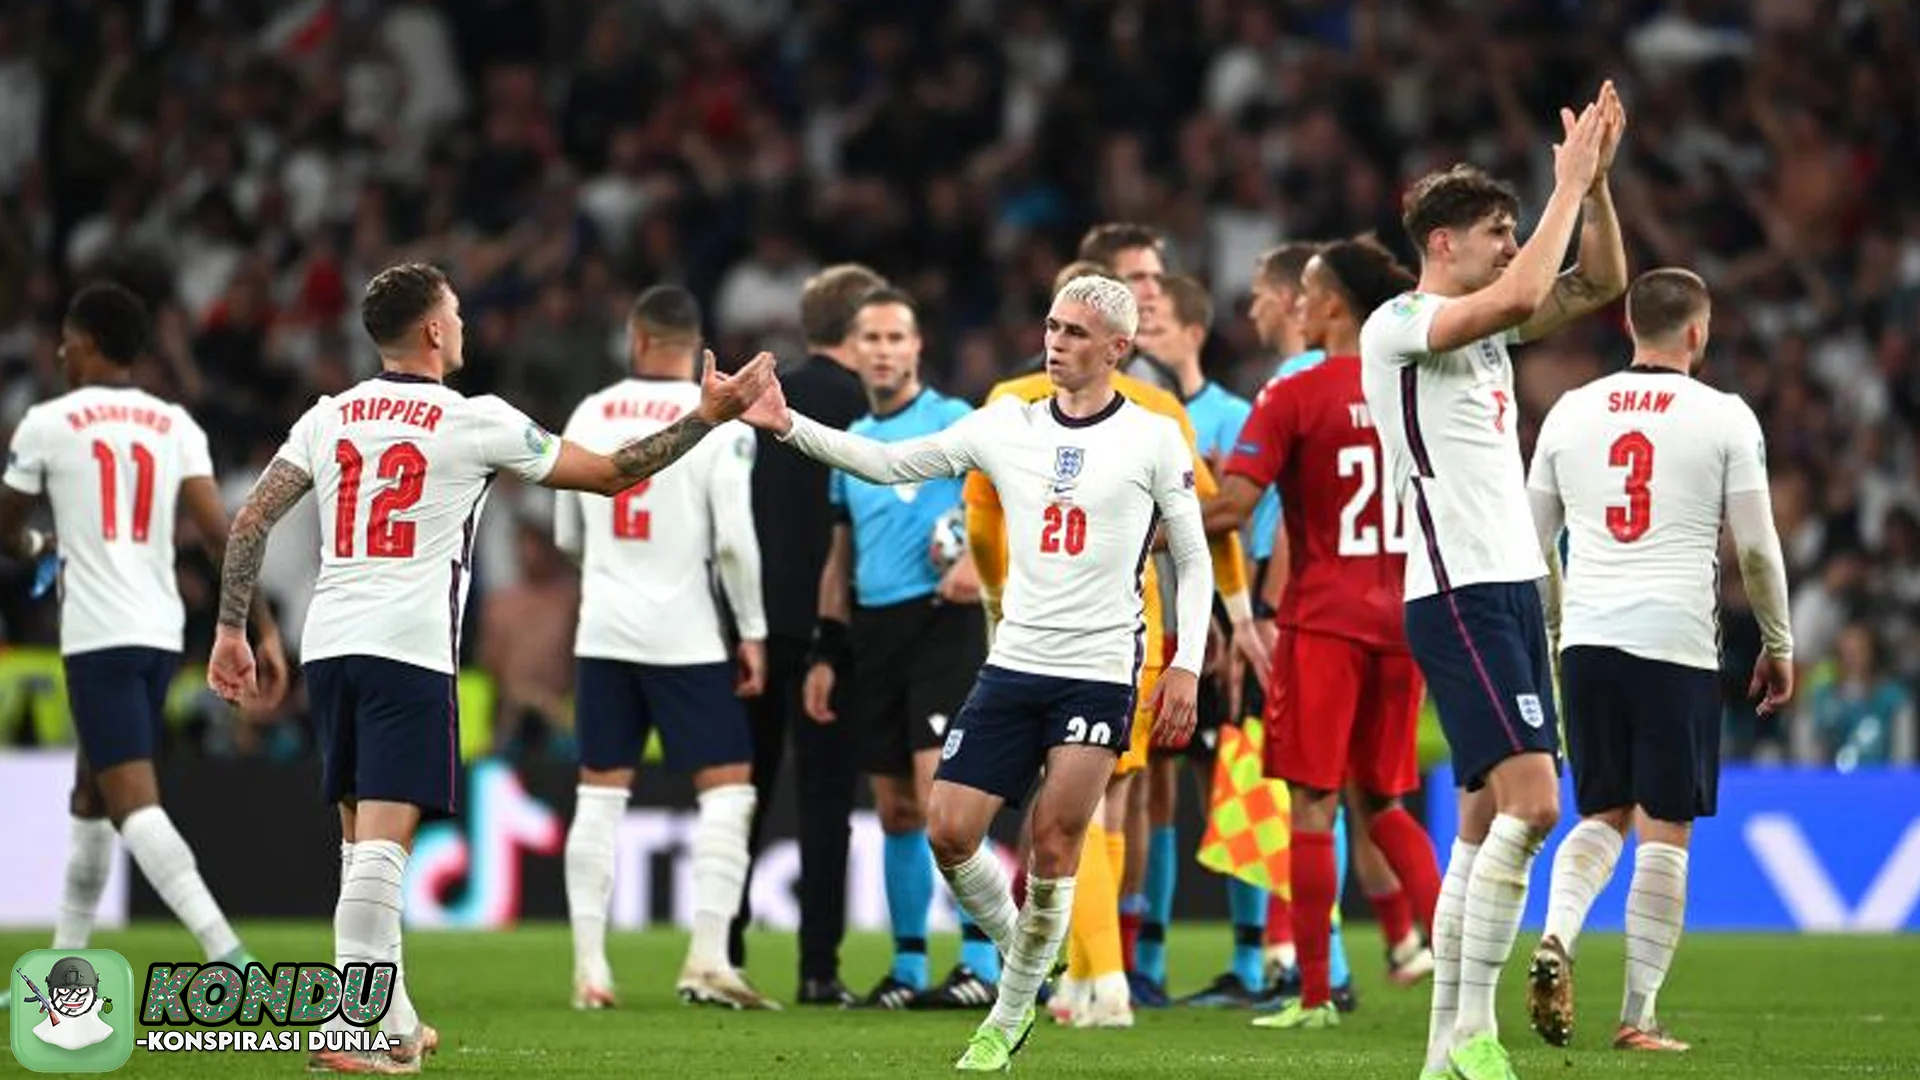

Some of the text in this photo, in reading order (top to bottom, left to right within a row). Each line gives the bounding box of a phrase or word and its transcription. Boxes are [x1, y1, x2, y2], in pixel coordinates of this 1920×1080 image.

[339, 398, 443, 432] TRIPPIER
[1608, 390, 1676, 413] SHAW
[92, 438, 154, 544] 11
[335, 439, 428, 558] 12
[1605, 430, 1655, 543] 3
[1040, 503, 1087, 556] 20
